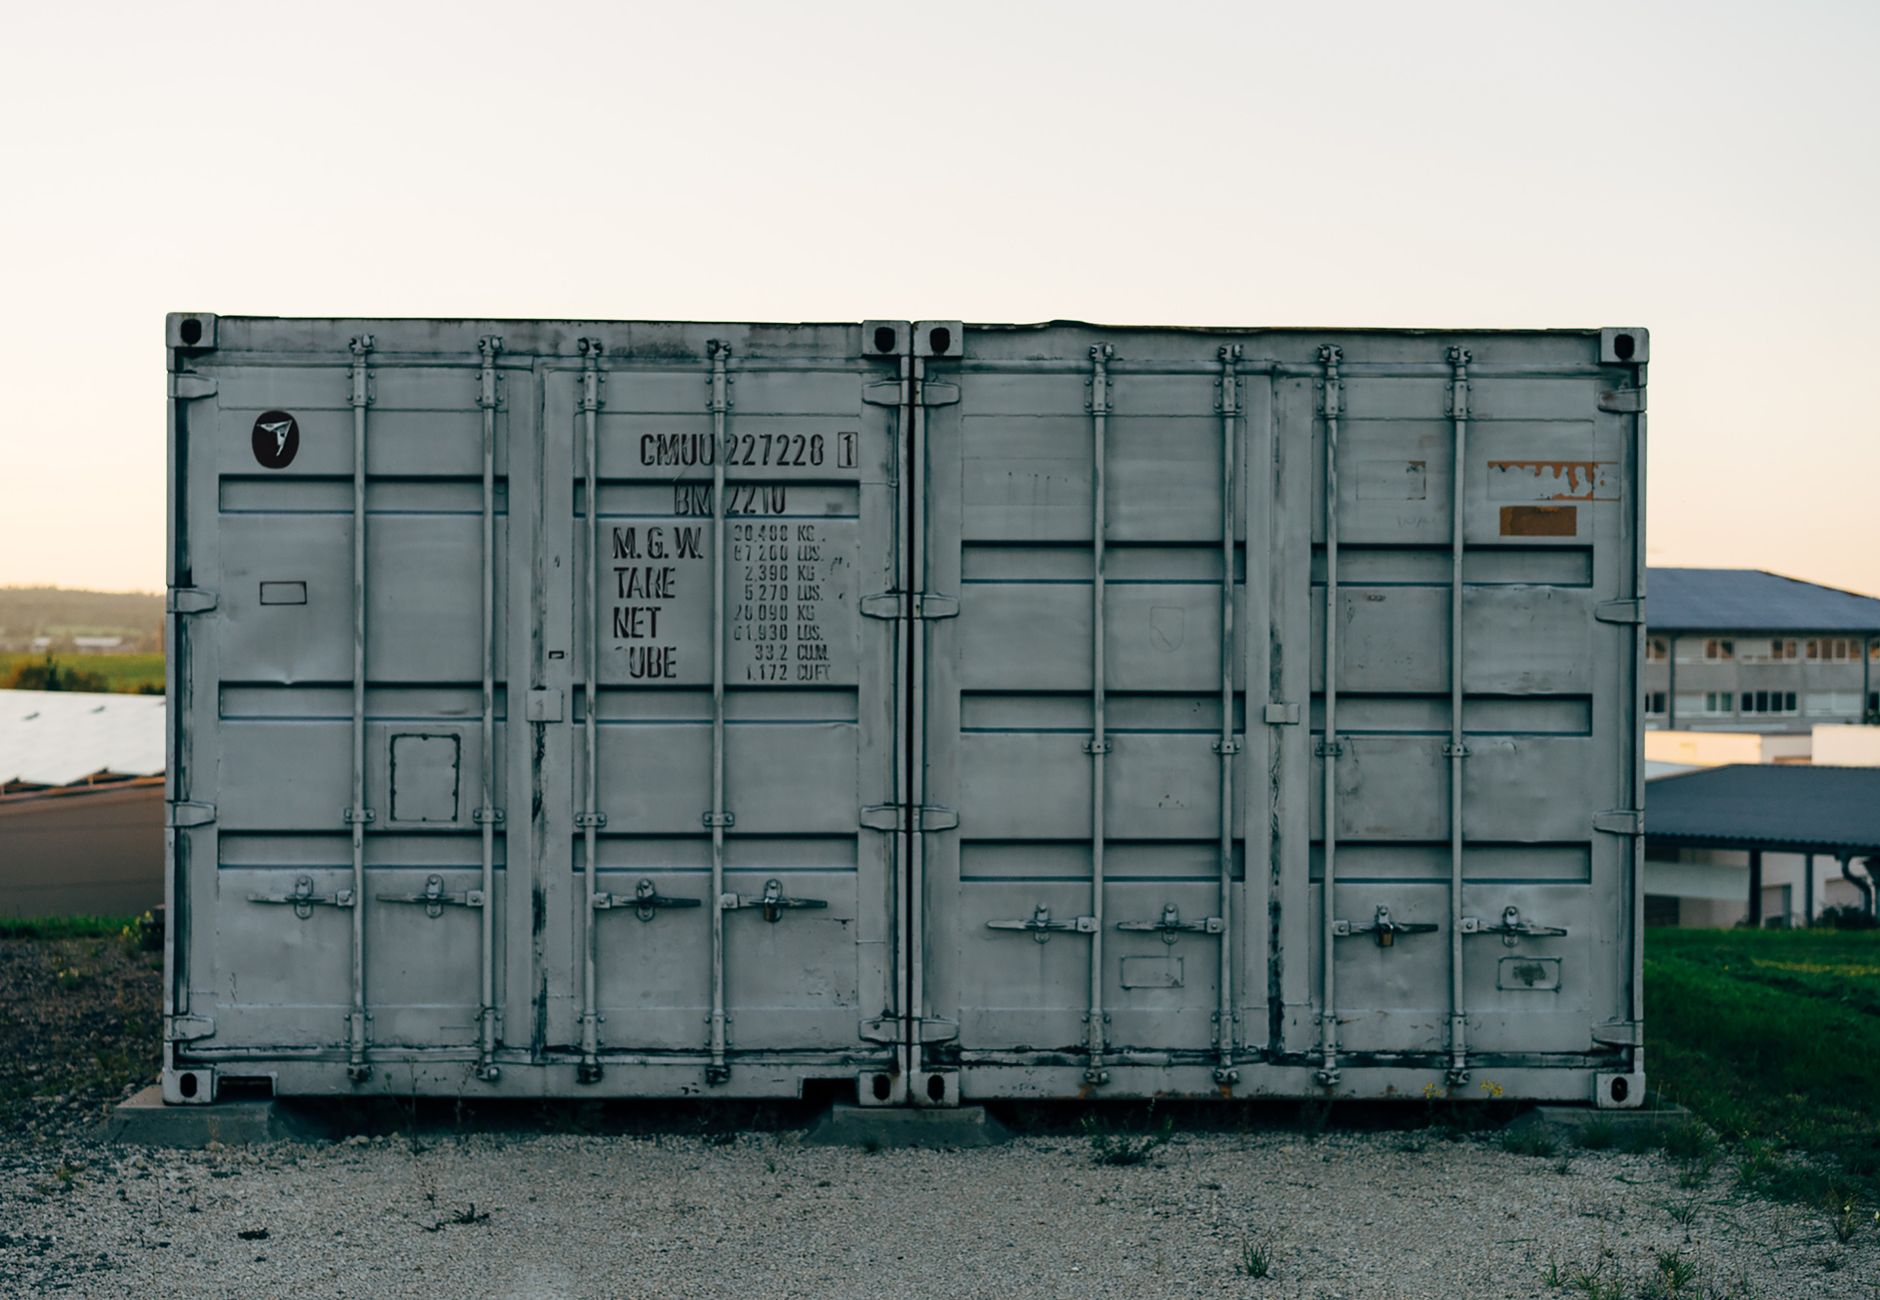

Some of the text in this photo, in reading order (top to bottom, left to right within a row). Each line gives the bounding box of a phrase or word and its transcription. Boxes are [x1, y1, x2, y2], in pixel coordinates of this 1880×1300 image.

[641, 433, 715, 466] CMUU
[724, 433, 824, 466] 227228
[613, 606, 661, 638] NET
[615, 646, 677, 679] UBE
